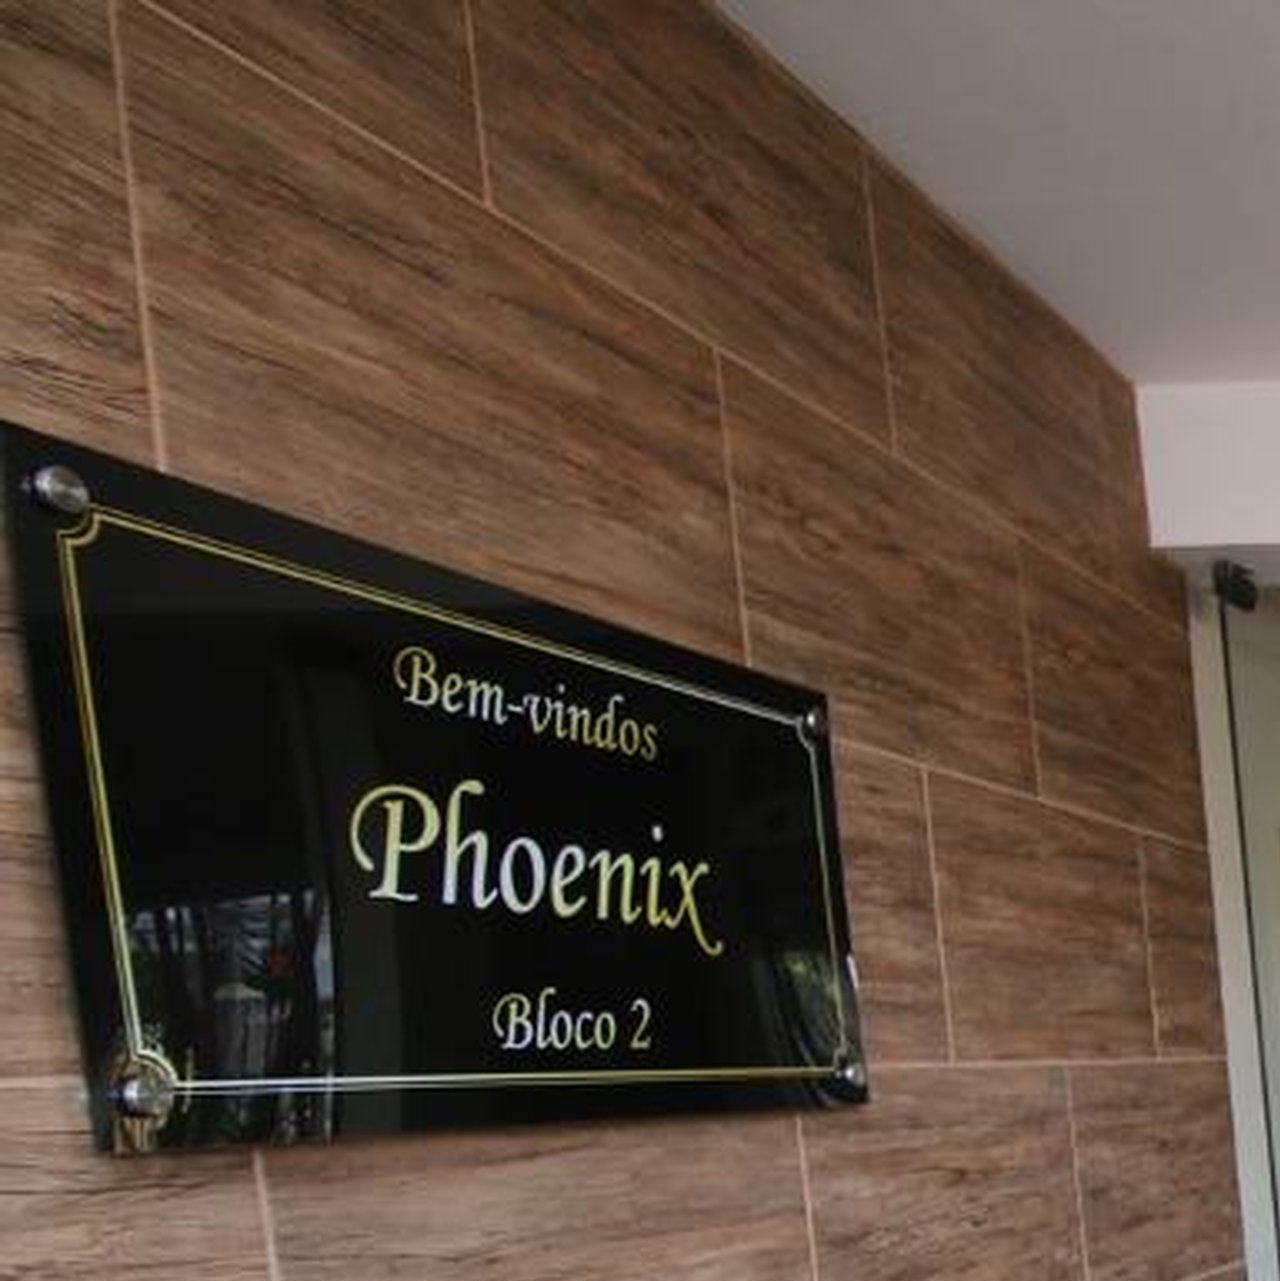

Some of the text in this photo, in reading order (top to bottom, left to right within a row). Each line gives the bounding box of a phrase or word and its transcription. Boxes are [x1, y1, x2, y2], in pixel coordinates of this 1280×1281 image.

[393, 645, 659, 760] Bem-vindos
[349, 779, 723, 956] Phoenix
[492, 986, 652, 1050] Bloco 2
